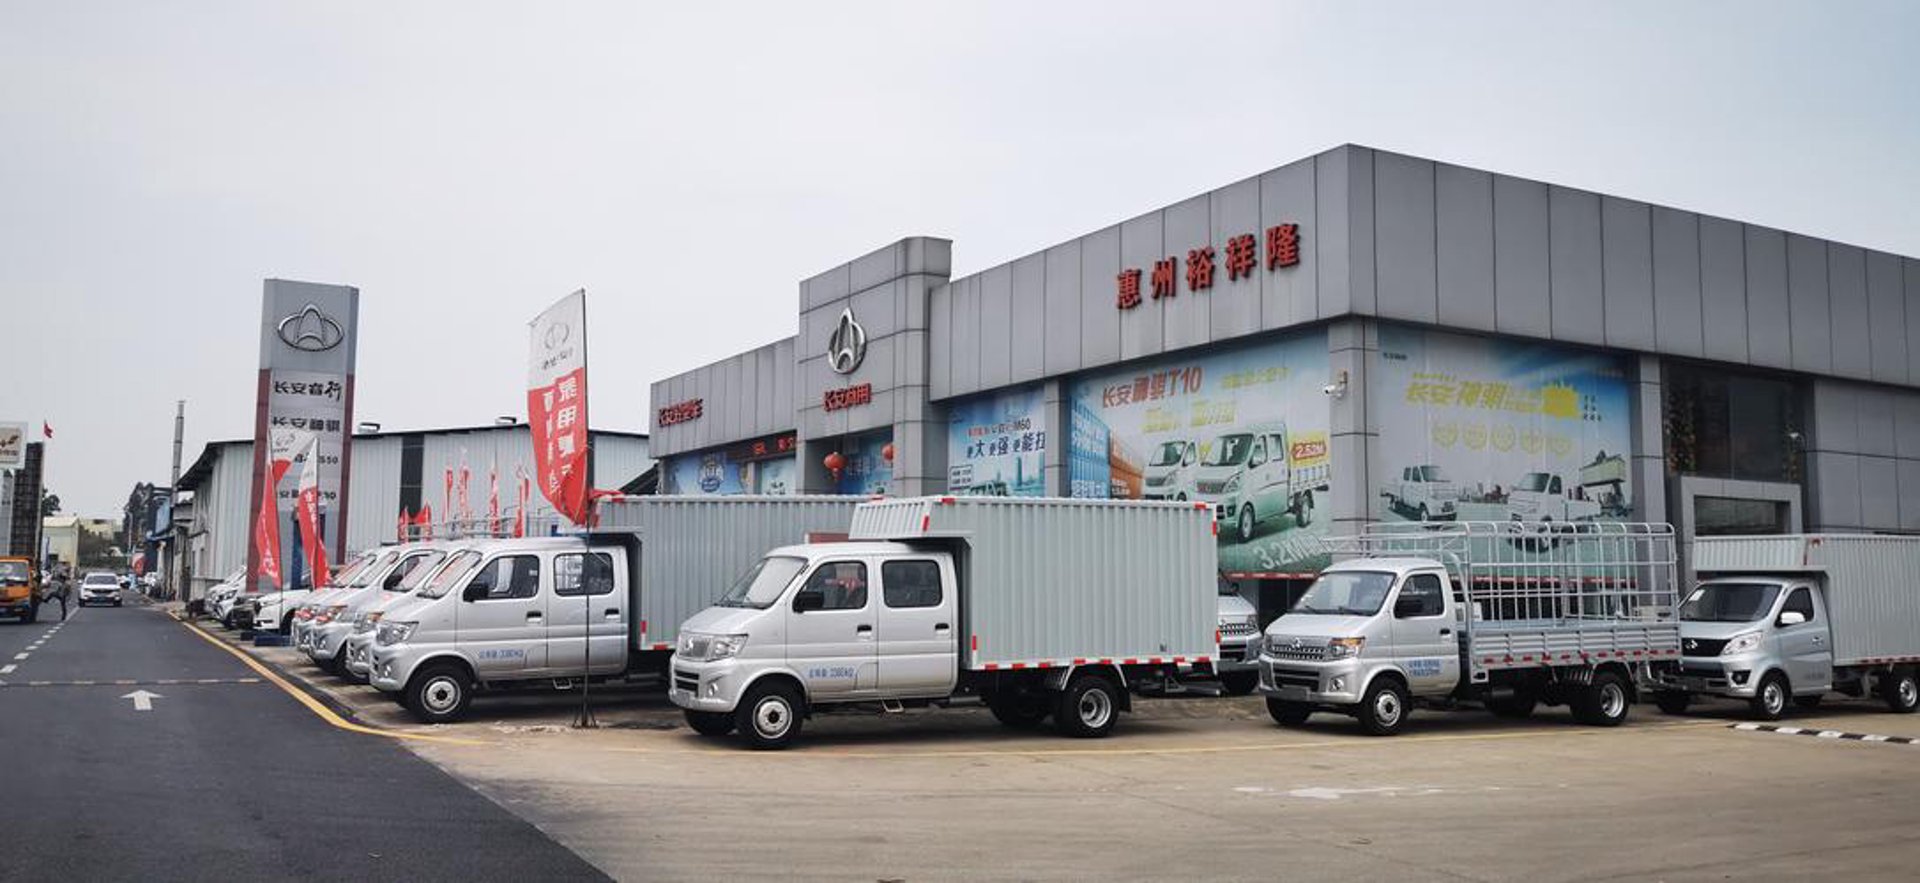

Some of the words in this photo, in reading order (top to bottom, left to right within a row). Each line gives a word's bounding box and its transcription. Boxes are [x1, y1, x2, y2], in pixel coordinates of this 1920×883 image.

[1117, 223, 1301, 310] 惠州裕祥隆
